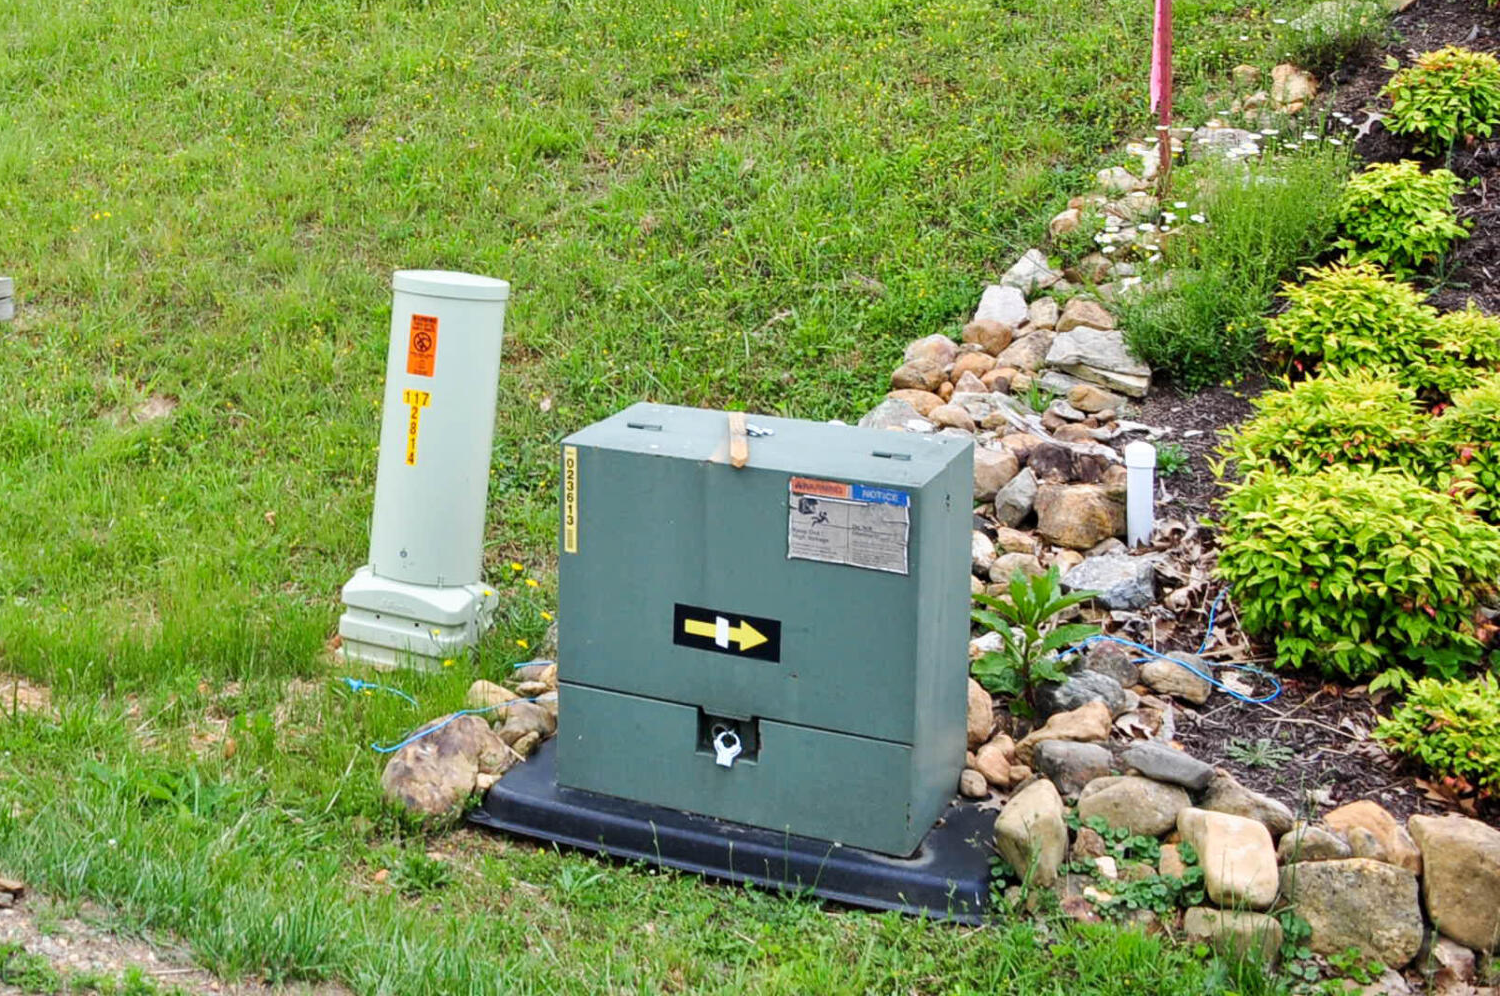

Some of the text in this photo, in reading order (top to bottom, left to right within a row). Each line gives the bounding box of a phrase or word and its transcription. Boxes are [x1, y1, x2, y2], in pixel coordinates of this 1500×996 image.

[405, 391, 430, 406] 117
[407, 406, 419, 464] 2814
[566, 458, 575, 526] 023613
[862, 489, 899, 502] NOTICE
